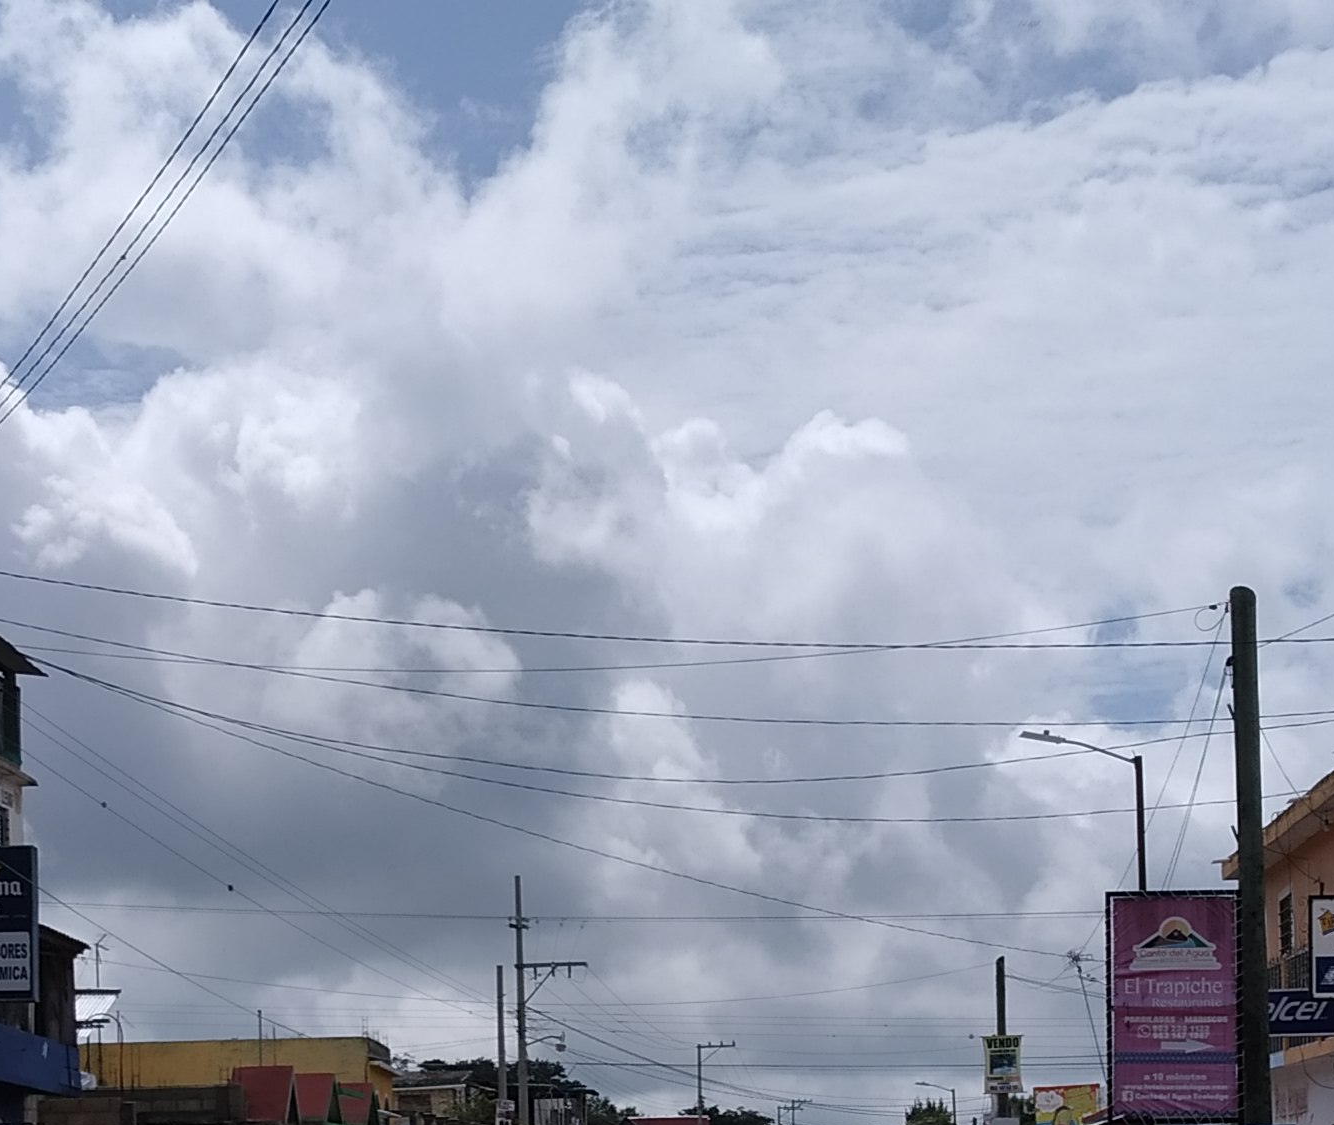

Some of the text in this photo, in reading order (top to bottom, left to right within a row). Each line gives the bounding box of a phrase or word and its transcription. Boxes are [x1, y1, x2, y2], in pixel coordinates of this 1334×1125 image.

[1139, 949, 1210, 958] Canto del Agua
[1124, 976, 1223, 998] El Trapiche
[1152, 997, 1223, 1008] Restaurante
[986, 1037, 1020, 1049] VENDO
[1153, 1073, 1164, 1081] 10
